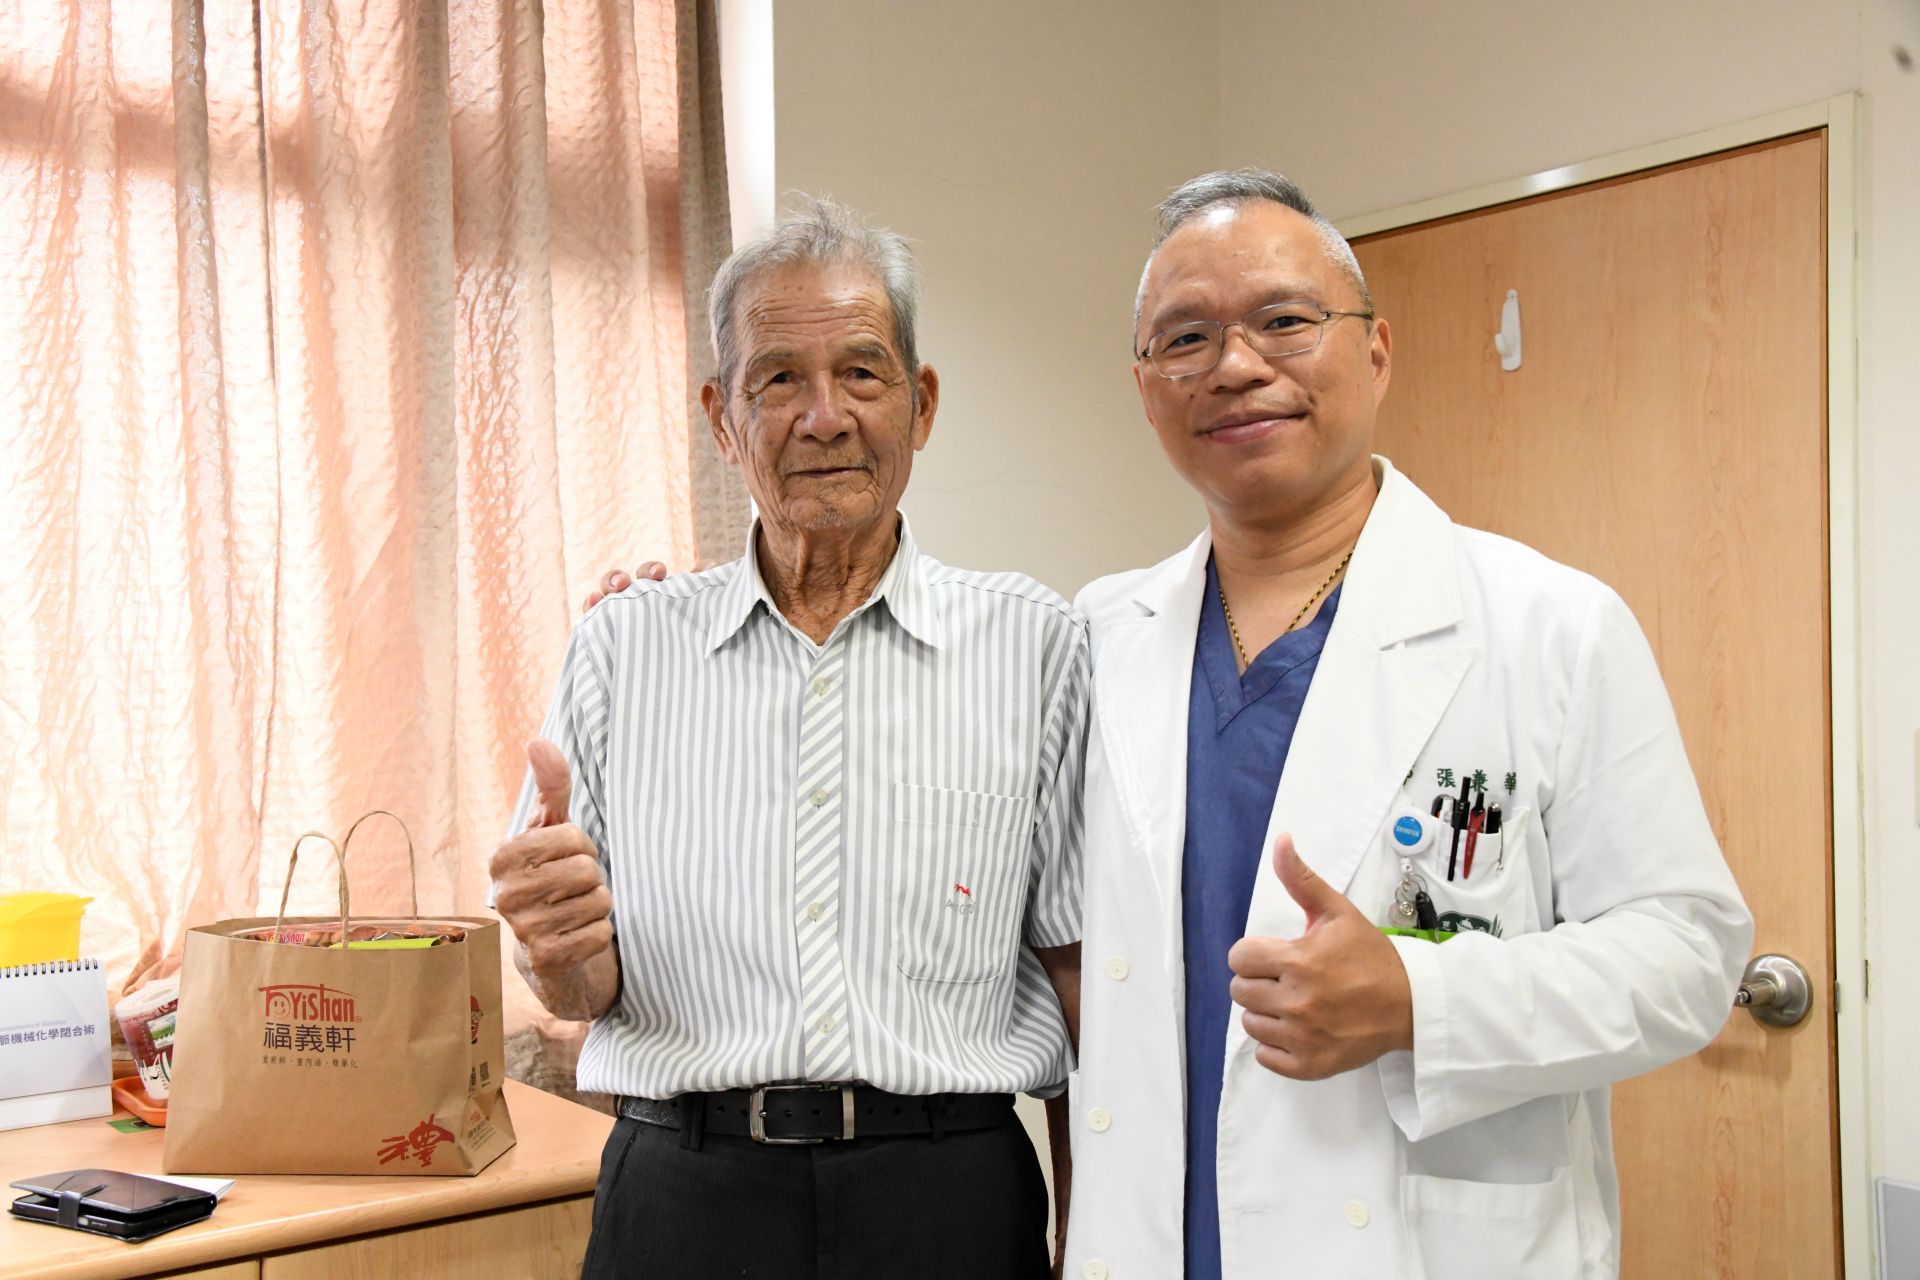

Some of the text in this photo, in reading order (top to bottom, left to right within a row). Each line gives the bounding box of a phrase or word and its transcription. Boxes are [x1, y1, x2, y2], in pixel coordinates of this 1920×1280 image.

[289, 984, 355, 1022] YiShan
[264, 1022, 356, 1053] 福義軒
